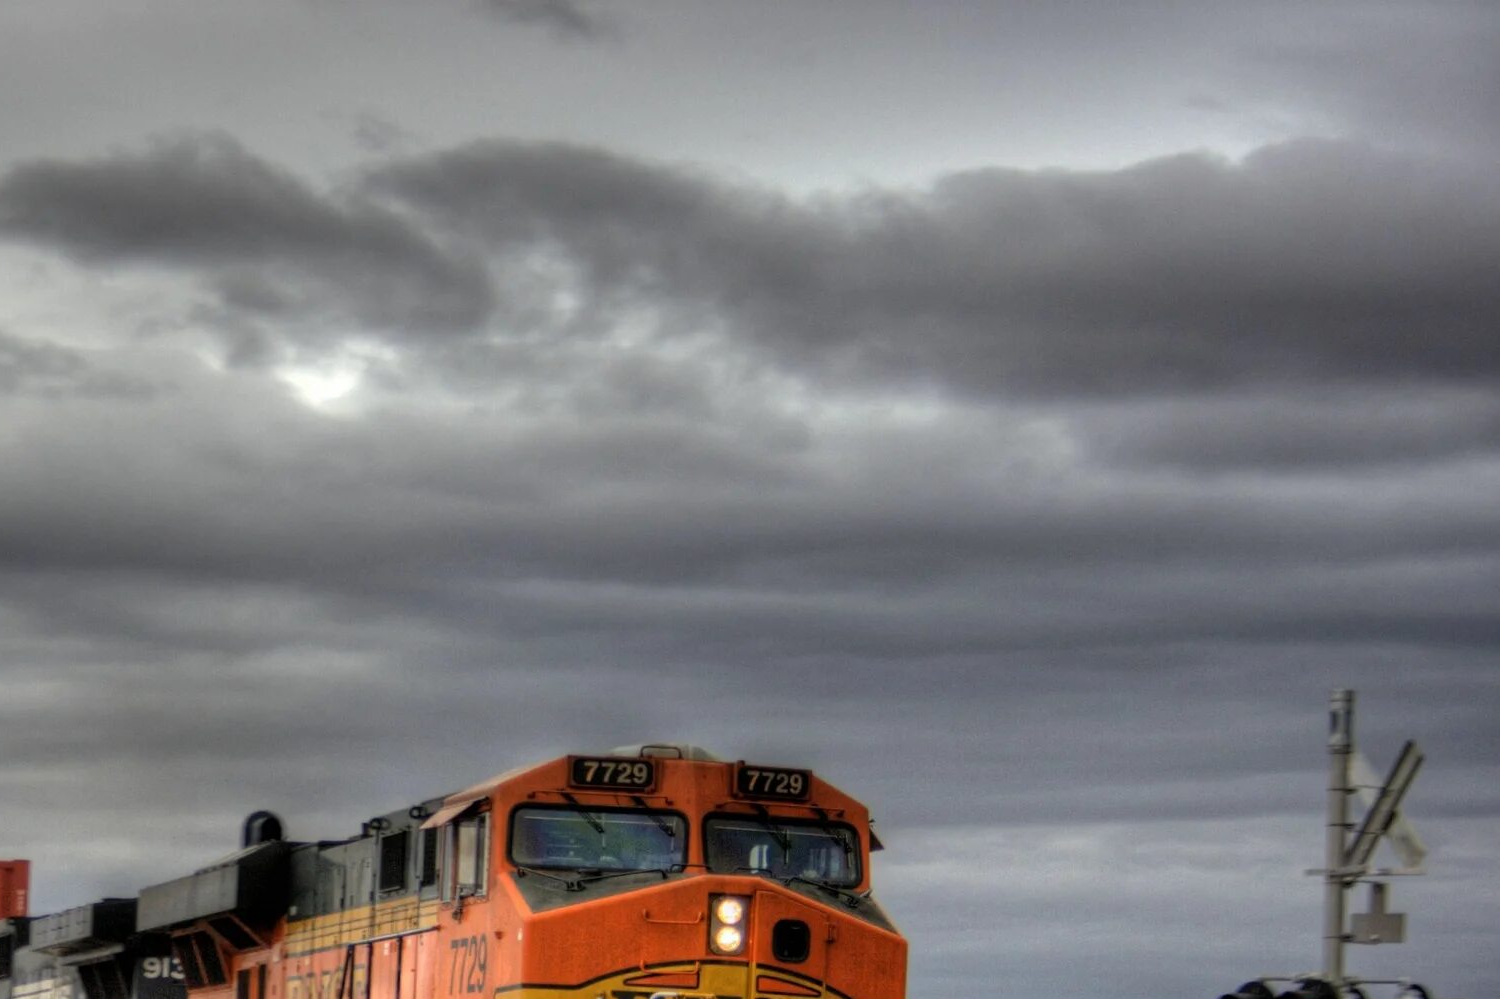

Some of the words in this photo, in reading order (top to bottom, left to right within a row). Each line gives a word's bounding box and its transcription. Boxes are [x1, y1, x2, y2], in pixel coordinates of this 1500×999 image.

[583, 760, 649, 785] 7729
[746, 770, 804, 795] 7729
[449, 933, 488, 996] 7729
